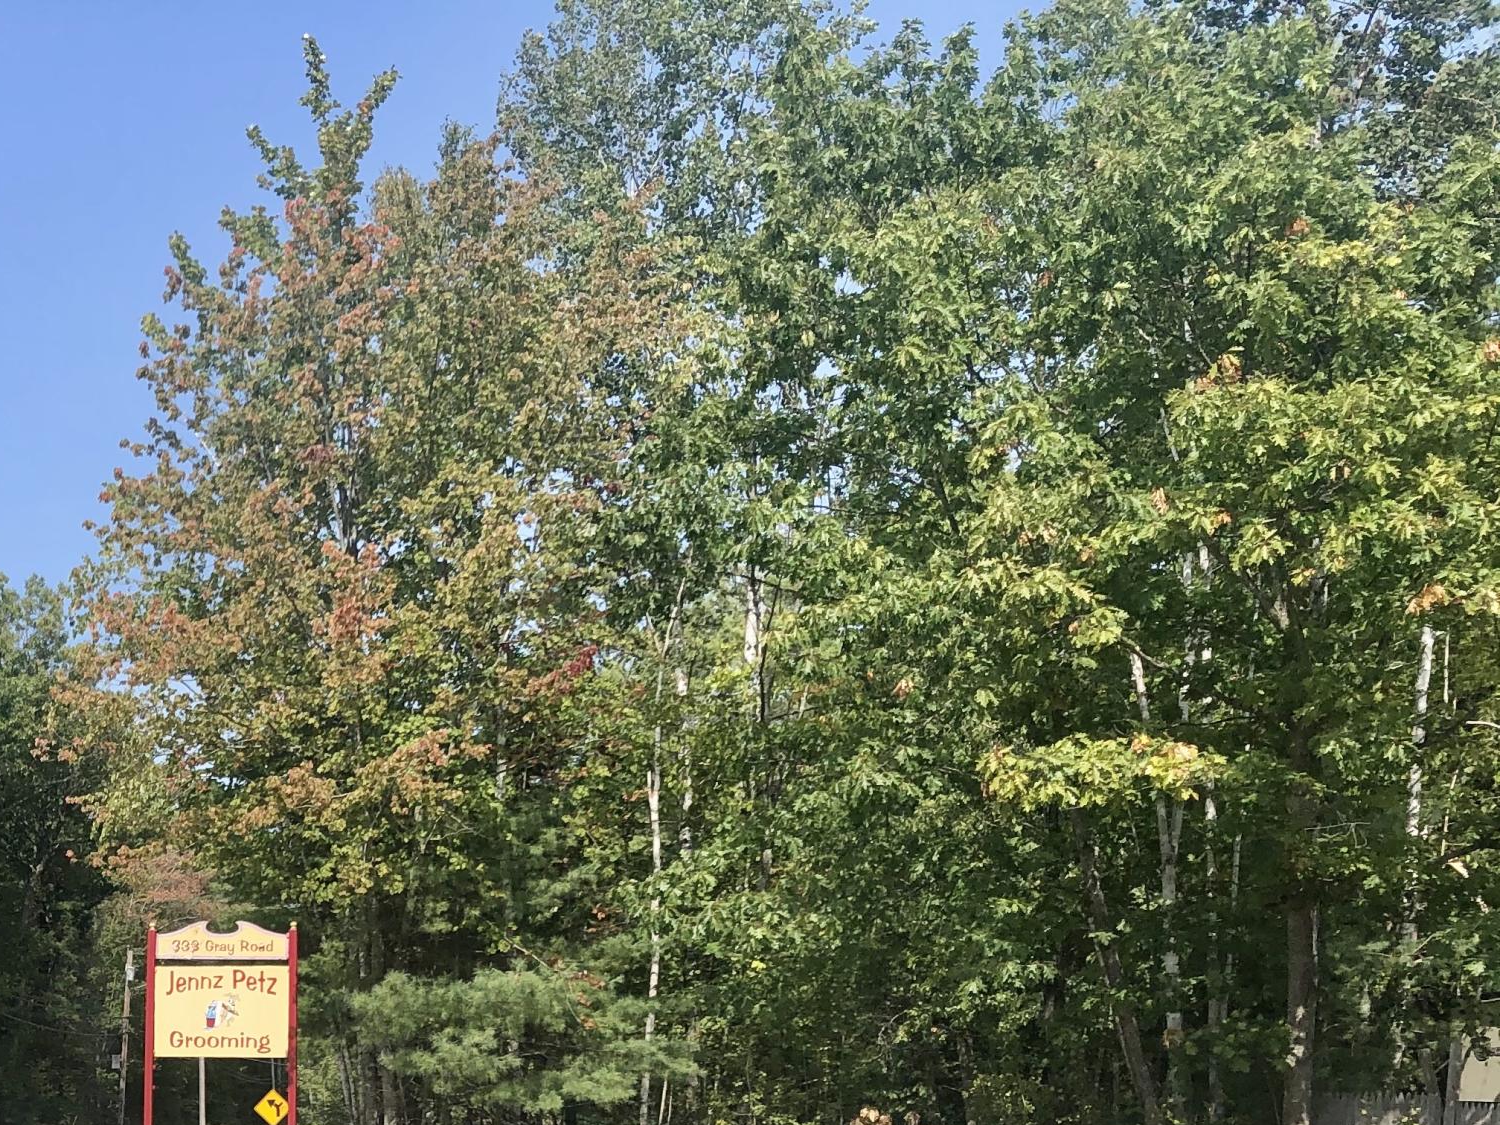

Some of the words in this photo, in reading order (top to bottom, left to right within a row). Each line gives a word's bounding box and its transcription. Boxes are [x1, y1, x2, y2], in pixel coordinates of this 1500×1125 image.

[205, 940, 235, 955] Gray
[240, 940, 274, 952] Road
[166, 970, 224, 995] Jennz
[232, 969, 277, 995] Petz
[170, 1031, 271, 1054] Grooming
